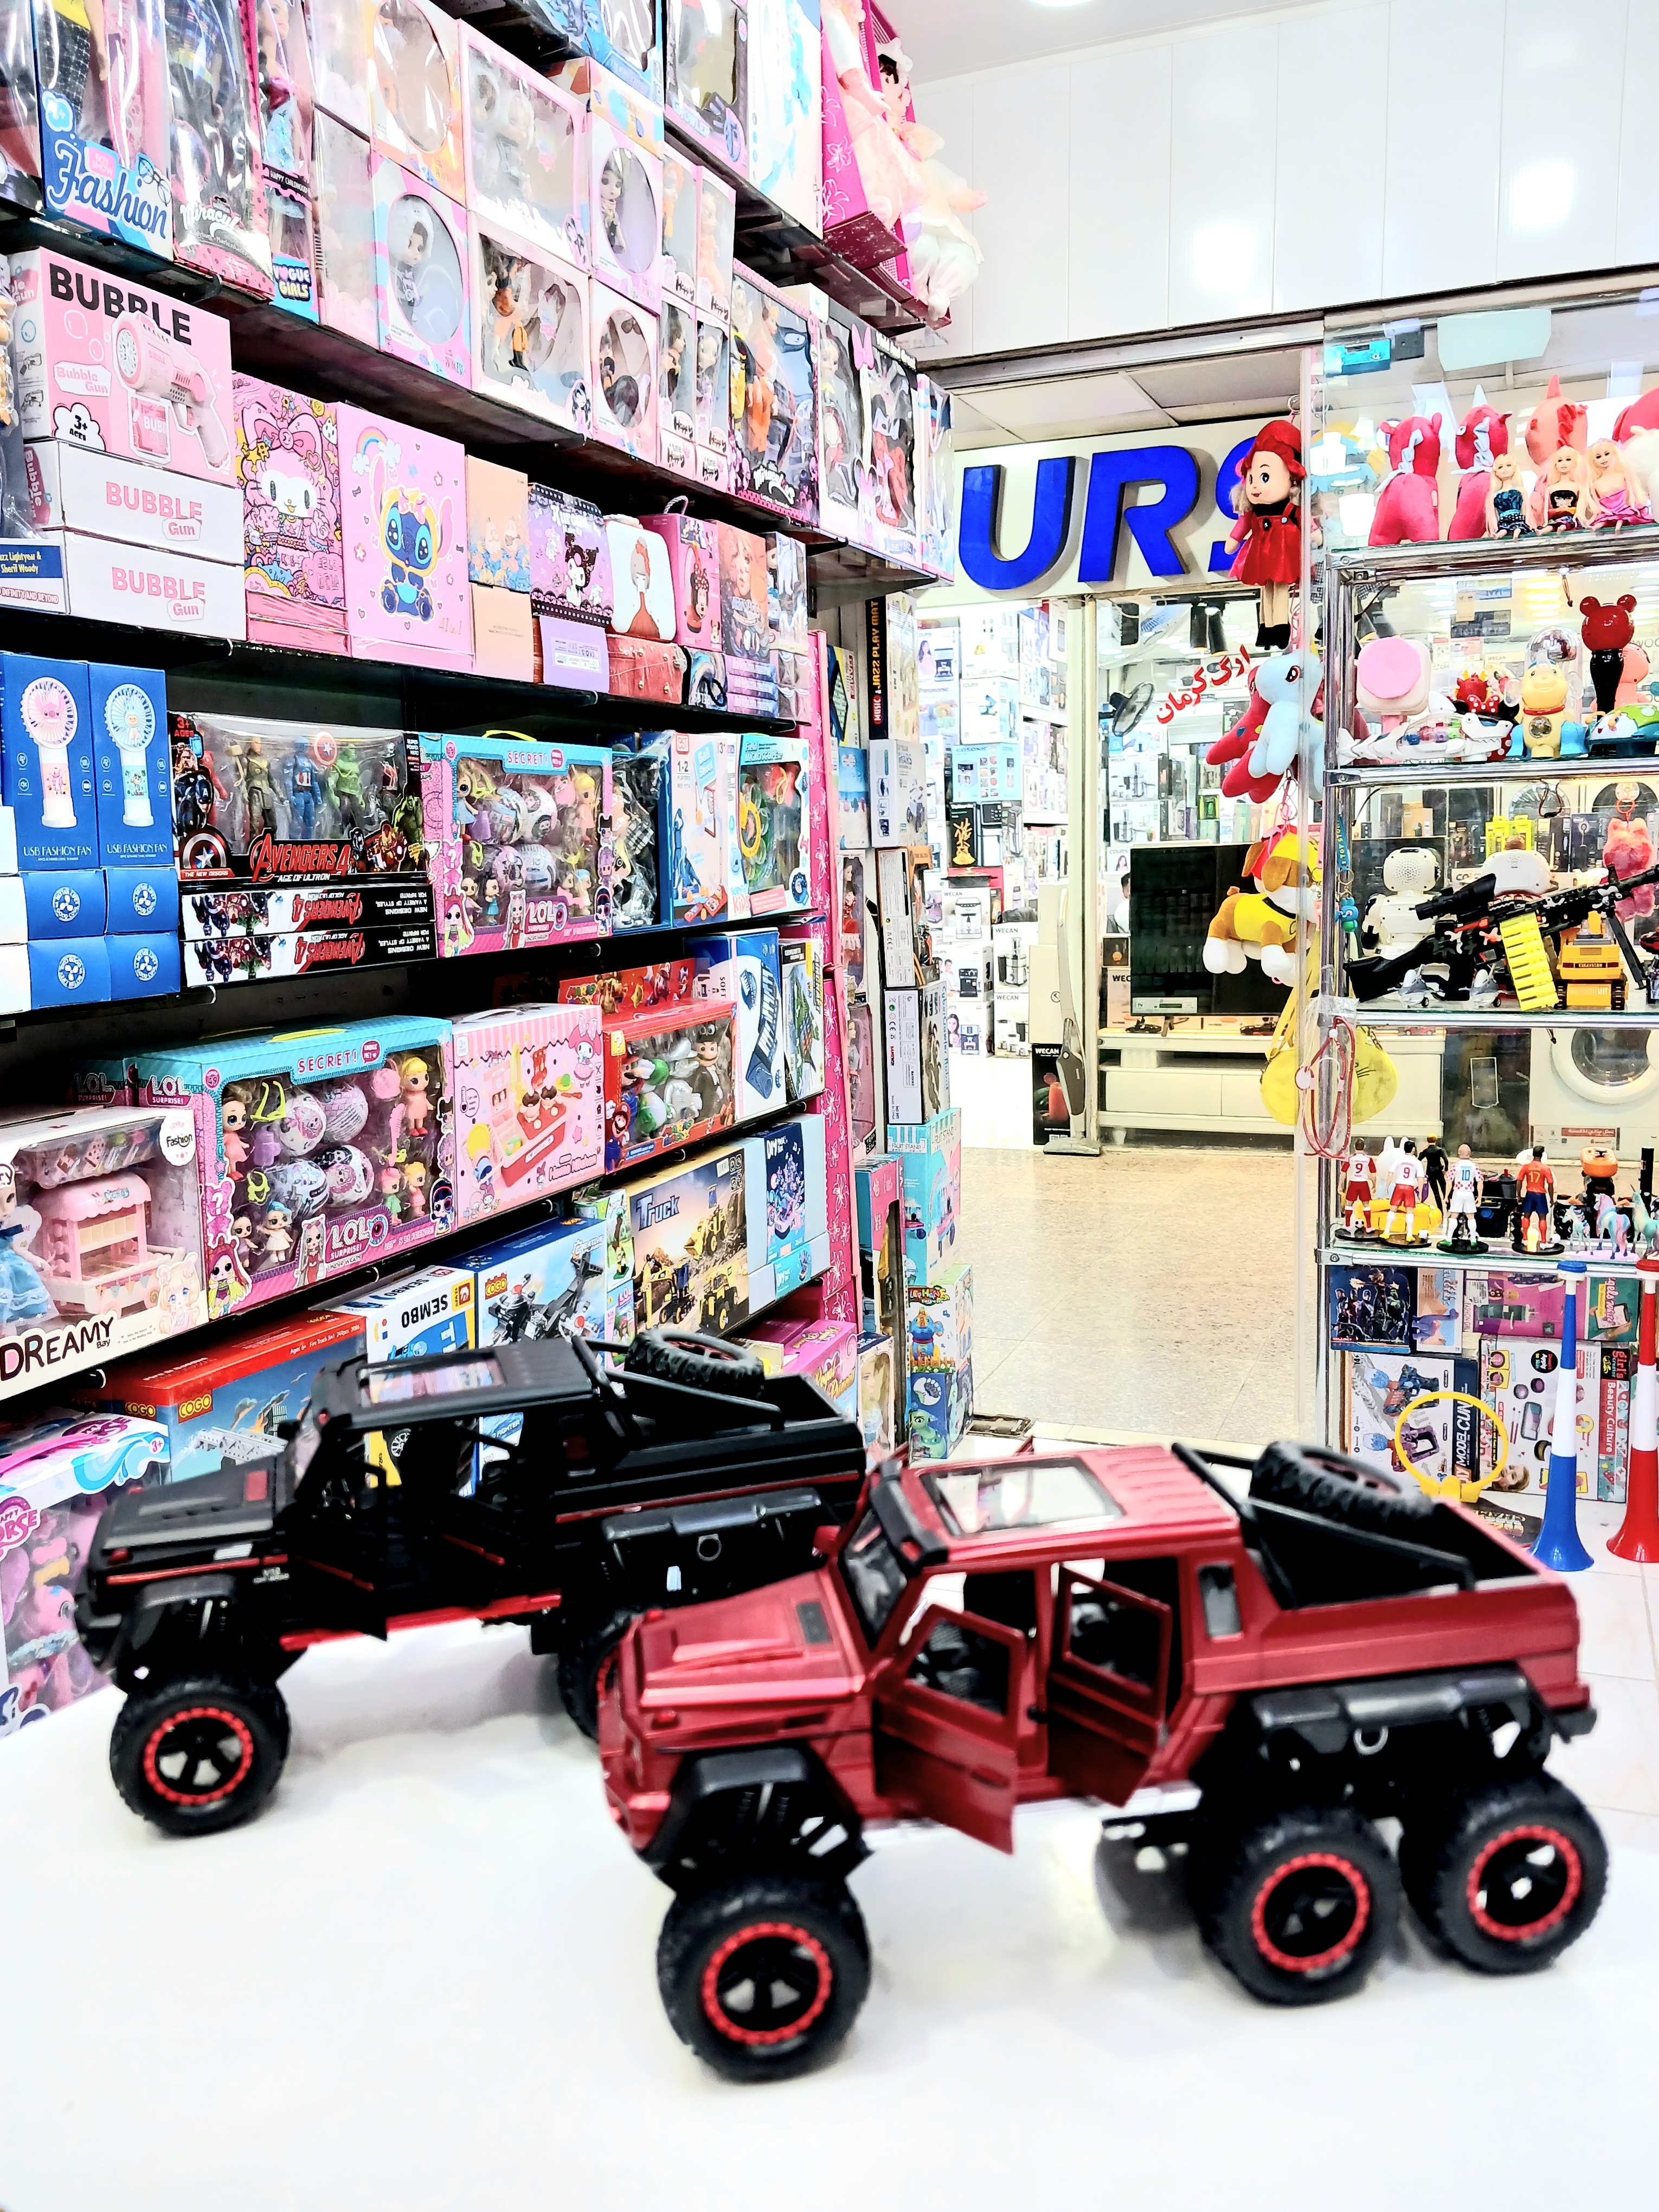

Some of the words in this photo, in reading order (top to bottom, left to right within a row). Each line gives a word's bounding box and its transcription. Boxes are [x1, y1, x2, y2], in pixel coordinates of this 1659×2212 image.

[95, 152, 110, 165] BOY
[91, 160, 113, 176] SHOW
[48, 140, 166, 239] Fashion
[13, 288, 35, 303] Gun
[278, 282, 308, 297] GIRLS
[56, 366, 98, 382] Bubble
[85, 382, 108, 394] Gun
[73, 415, 88, 431] 3+
[24, 449, 42, 506] Bubble
[106, 481, 202, 523] BUBBLE
[550, 504, 589, 529] Kuromi
[168, 522, 195, 536] Gun
[18, 564, 39, 575] Woody
[112, 567, 206, 603] BUBBLE
[2, 588, 24, 599] INFINITY
[25, 591, 37, 600] AND
[37, 593, 59, 605] BEYOND
[173, 603, 199, 616] Gun
[871, 600, 879, 626] MAT
[872, 628, 880, 658] PLAY
[1156, 666, 1207, 724] کرمان
[873, 698, 882, 722] MUSIC
[177, 716, 190, 729] 3+
[507, 750, 549, 766] SECRET!
[698, 747, 710, 764] Ball
[23, 846, 41, 856] USB
[42, 845, 76, 857] FASHION
[77, 845, 92, 856] FAN
[106, 844, 121, 854] USB
[123, 843, 153, 854] FASHION
[155, 843, 168, 853] FAN
[250, 834, 338, 883] AVENGERS
[336, 844, 351, 877] 4
[277, 874, 292, 883] AGE
[292, 874, 301, 882] OF
[301, 873, 331, 882] ULTRON
[292, 894, 305, 923] 4
[304, 892, 363, 925] AVENGERS
[294, 936, 308, 965] 4
[307, 933, 365, 964] AVENGERS
[387, 946, 414, 954] DESIGNS
[1112, 974, 1131, 982] WEC
[298, 1050, 357, 1073] SECRET!
[151, 1075, 191, 1096] LOL
[152, 1097, 184, 1106] SURPRISE!
[166, 1133, 192, 1148] Fashion
[766, 1138, 777, 1160] DIY
[549, 1163, 571, 1182] Home
[571, 1154, 597, 1173] Kitchen
[1355, 1163, 1363, 1174] 9
[1403, 1167, 1410, 1179] 9
[1462, 1169, 1470, 1181] 10
[1528, 1171, 1540, 1183] 17
[332, 1216, 371, 1249] LOL
[330, 1243, 363, 1261] SURPRISE!
[387, 1277, 430, 1297] SEMBO
[485, 1277, 507, 1296] COGO
[401, 1294, 448, 1328] SEMBO
[1, 1316, 113, 1381] DREAMY
[96, 1338, 110, 1349] Bay
[290, 1346, 301, 1355] Ages
[317, 1337, 328, 1345] Truck
[178, 1393, 212, 1418] COGO
[1606, 1382, 1616, 1417] Beauty
[125, 1401, 156, 1417] COGO
[1606, 1417, 1615, 1453] Culture
[151, 1440, 163, 1453] 3+
[1455, 1430, 1468, 1467] MODEL
